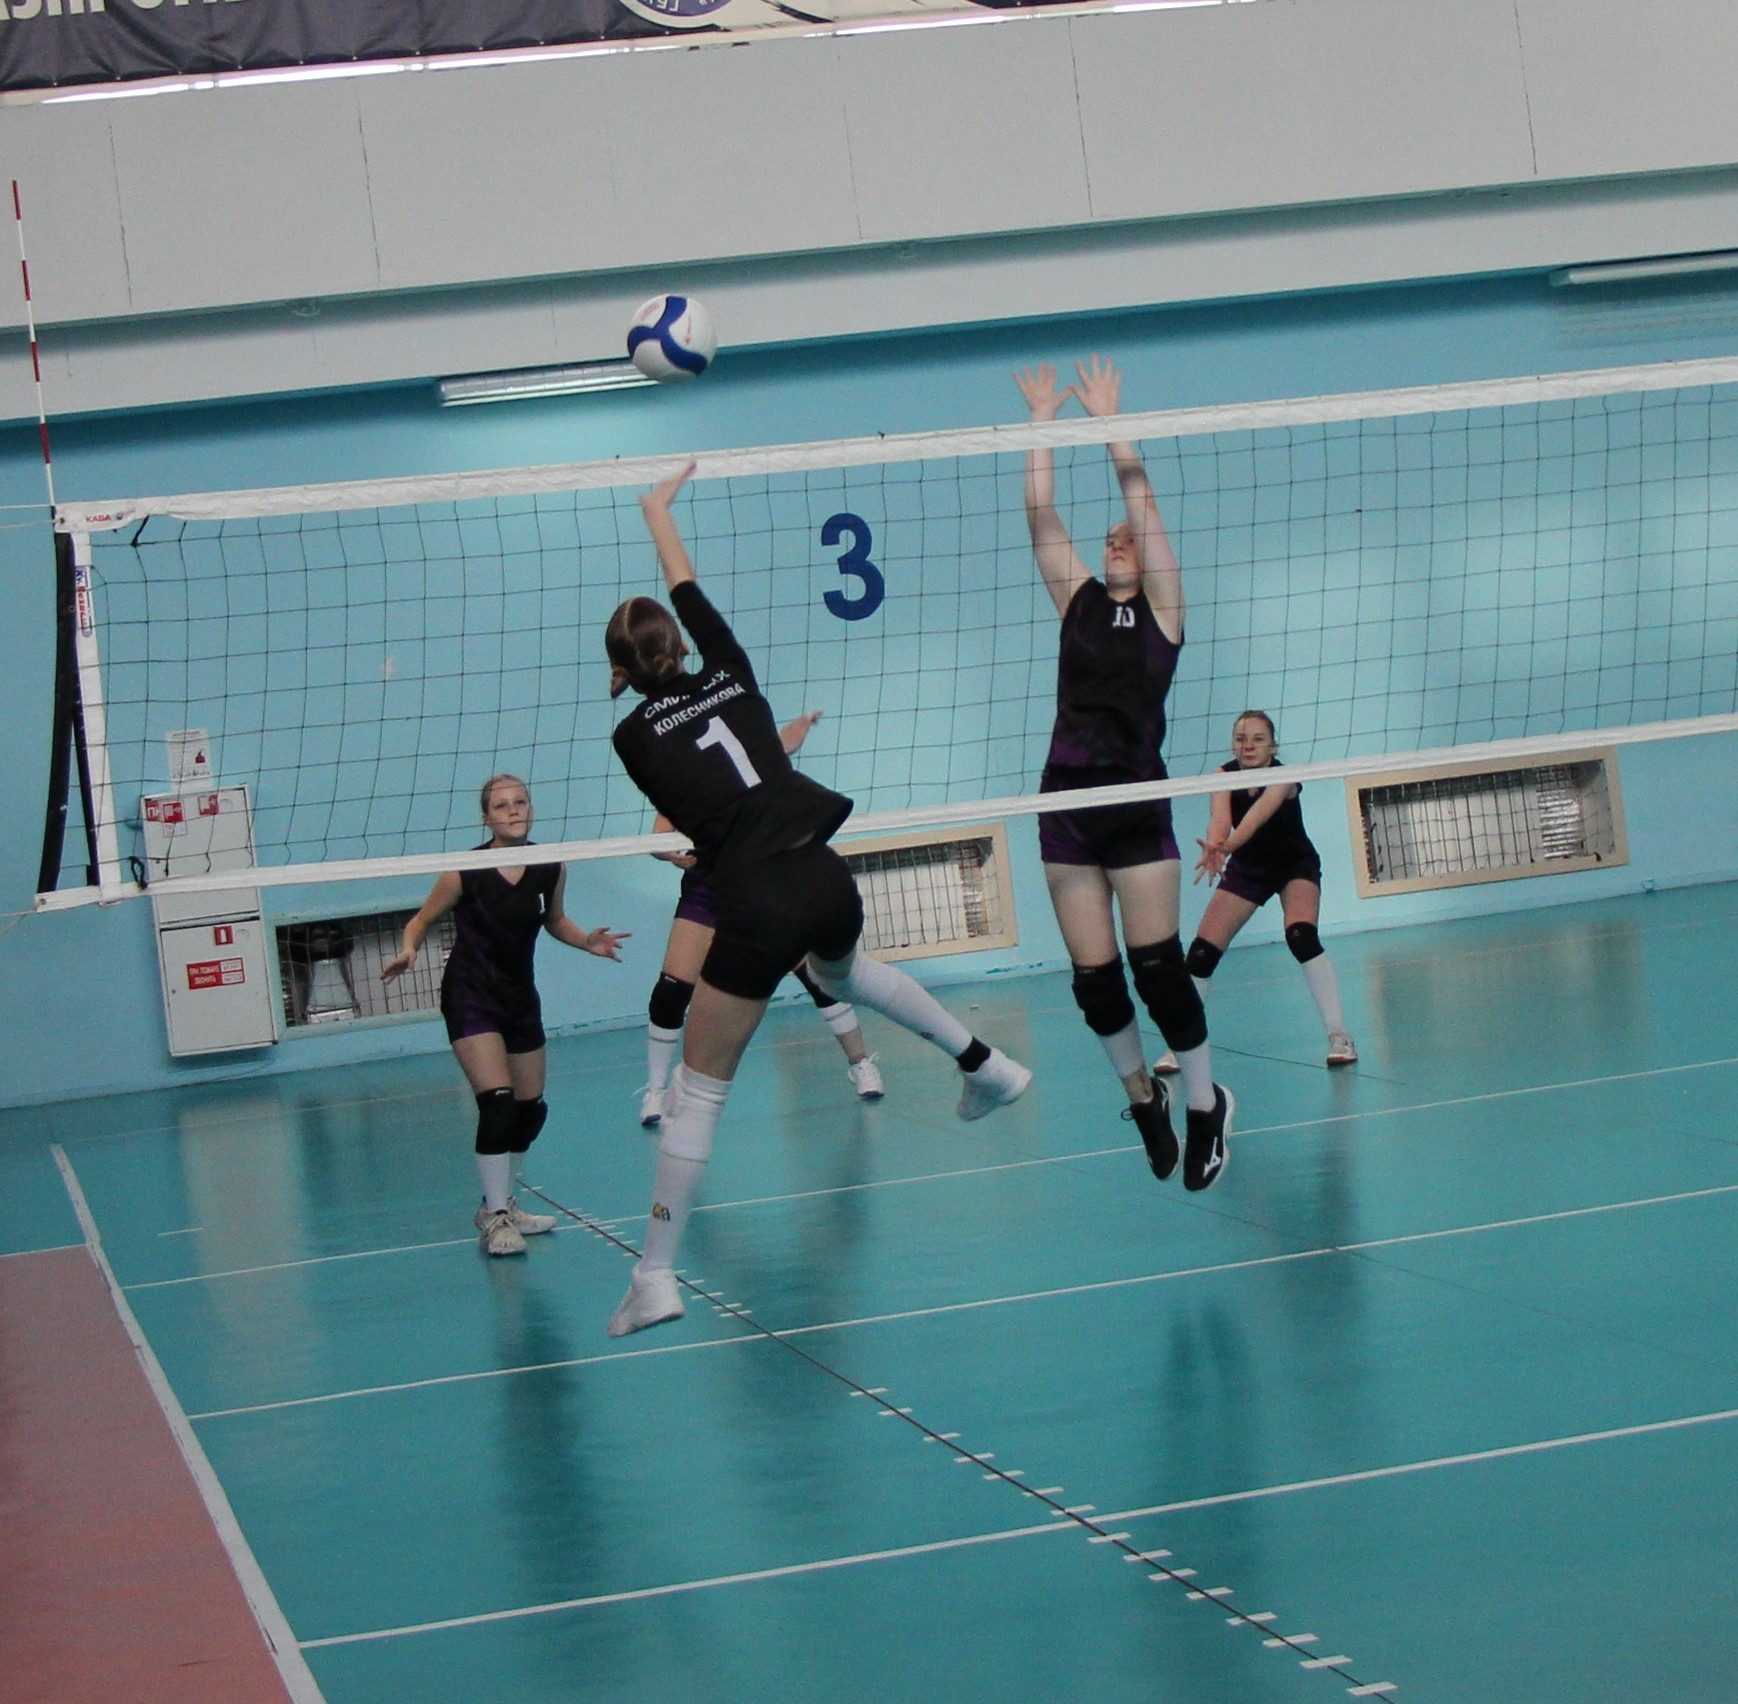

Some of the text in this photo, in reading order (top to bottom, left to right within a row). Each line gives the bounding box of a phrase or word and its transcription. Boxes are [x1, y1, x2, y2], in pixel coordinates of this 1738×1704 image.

[821, 513, 885, 621] 3
[1112, 605, 1136, 628] 10
[653, 682, 746, 737] КОЛЕСНИКОВА
[695, 715, 763, 789] 1
[538, 892, 546, 914] 1
